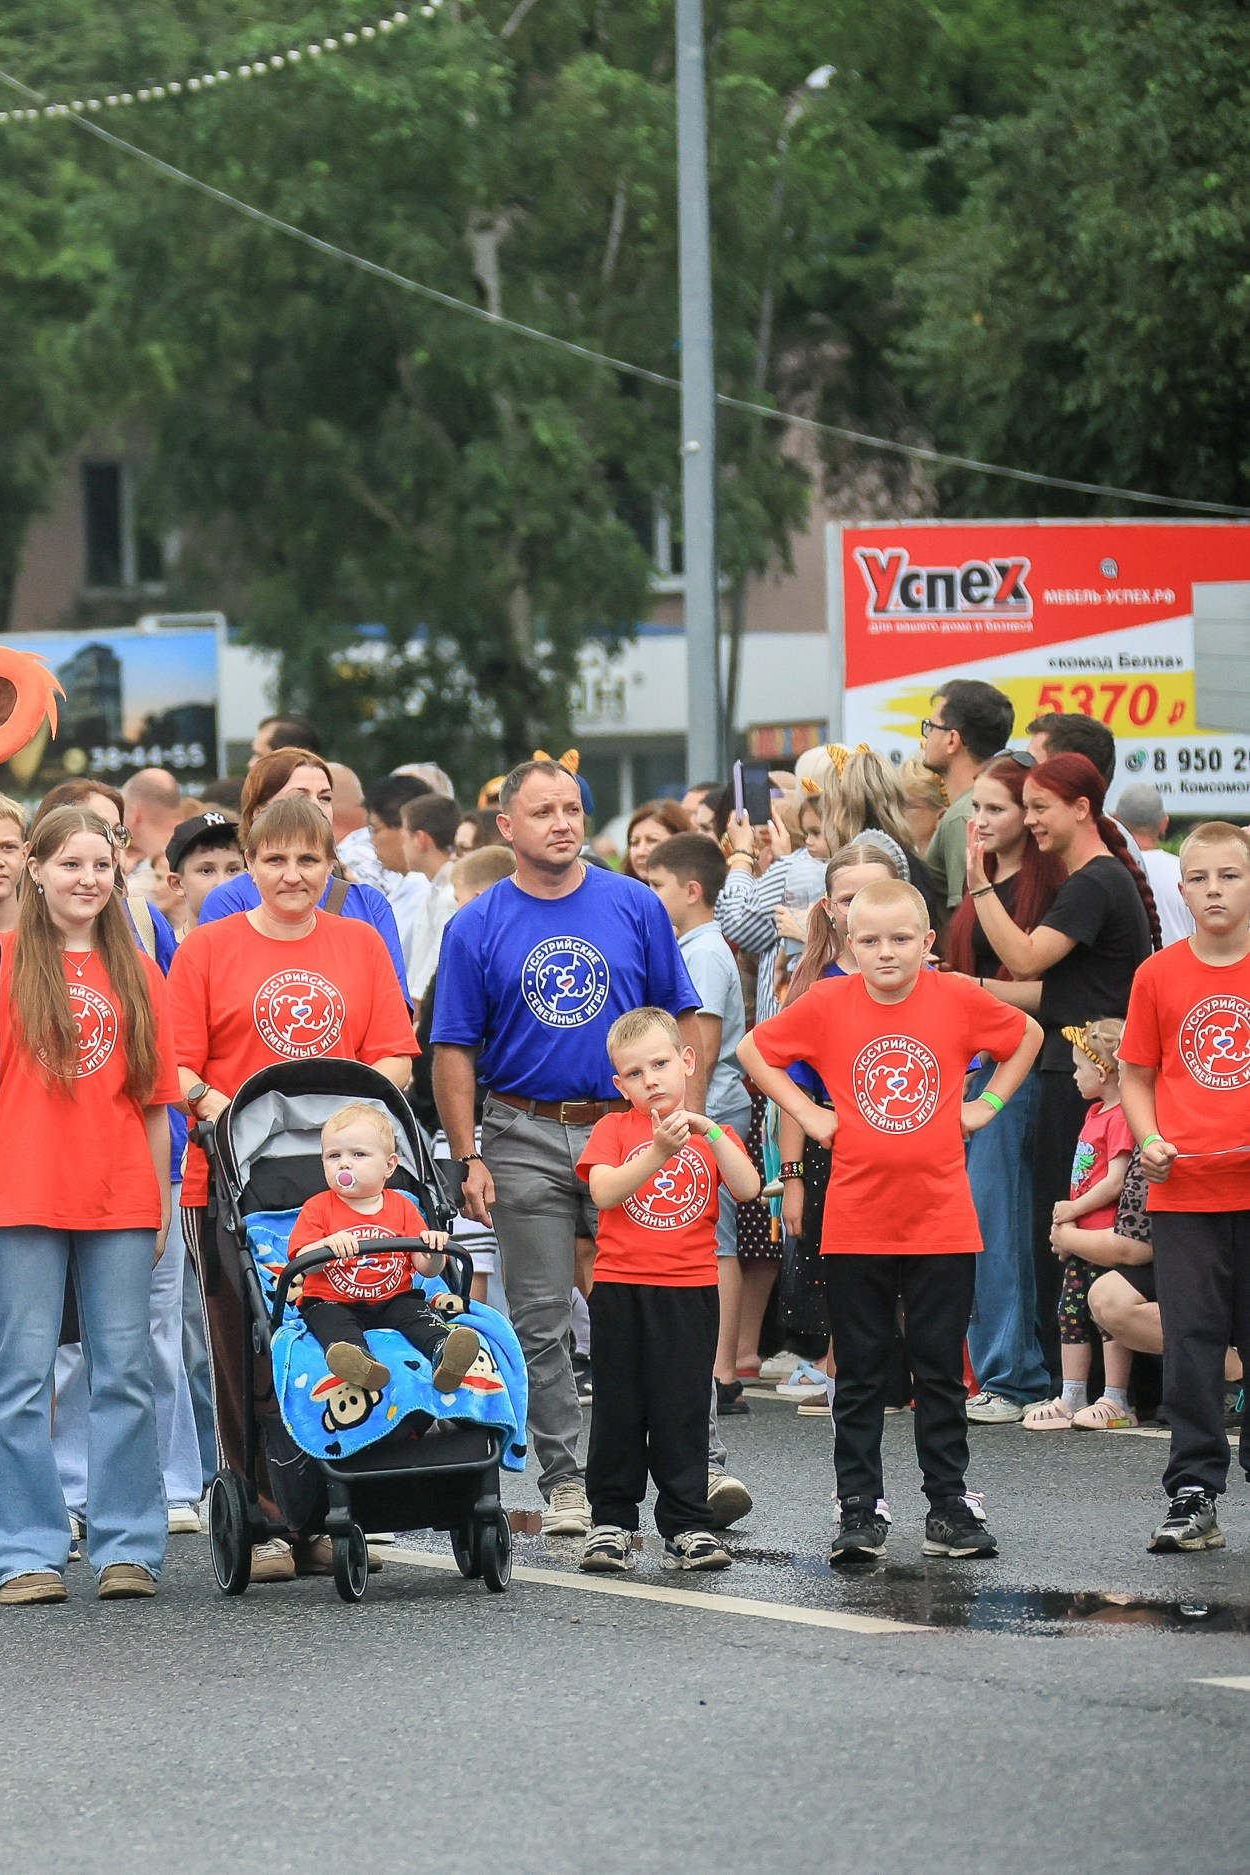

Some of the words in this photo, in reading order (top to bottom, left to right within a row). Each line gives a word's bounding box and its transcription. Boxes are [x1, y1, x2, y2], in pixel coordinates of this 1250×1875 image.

[856, 549, 1031, 616] Успех
[1036, 682, 1159, 727] 5370
[1153, 748, 1167, 772] 8
[1178, 747, 1222, 772] 950
[1233, 747, 1250, 772] 2
[526, 938, 601, 972] УССУРИЙСКИЕ
[69, 987, 112, 1019] ИЙСКИЕ
[260, 972, 338, 1000] УССУРИЙСКИЕ
[528, 991, 584, 1025] СЕМЕЙНЫЕ
[584, 983, 606, 1016] ИГРЫ
[1185, 998, 1250, 1032] УССУРИЙСК
[85, 1039, 112, 1070] ИГРЫ
[259, 1018, 319, 1057] СЕМЕЙНЫЕ
[857, 1037, 934, 1072] УССУРИЙСКИЕ
[1185, 1050, 1240, 1087] СЕМЕЙНЫЕ
[858, 1091, 914, 1131] СЕМЕЙНЫЕ
[915, 1089, 937, 1122] ИГРЫ
[625, 1196, 677, 1227] ЕМЕЙНЫЕ
[680, 1194, 705, 1223] ИГРЫ
[328, 1267, 382, 1298] ЕМЕЙНЫЕ
